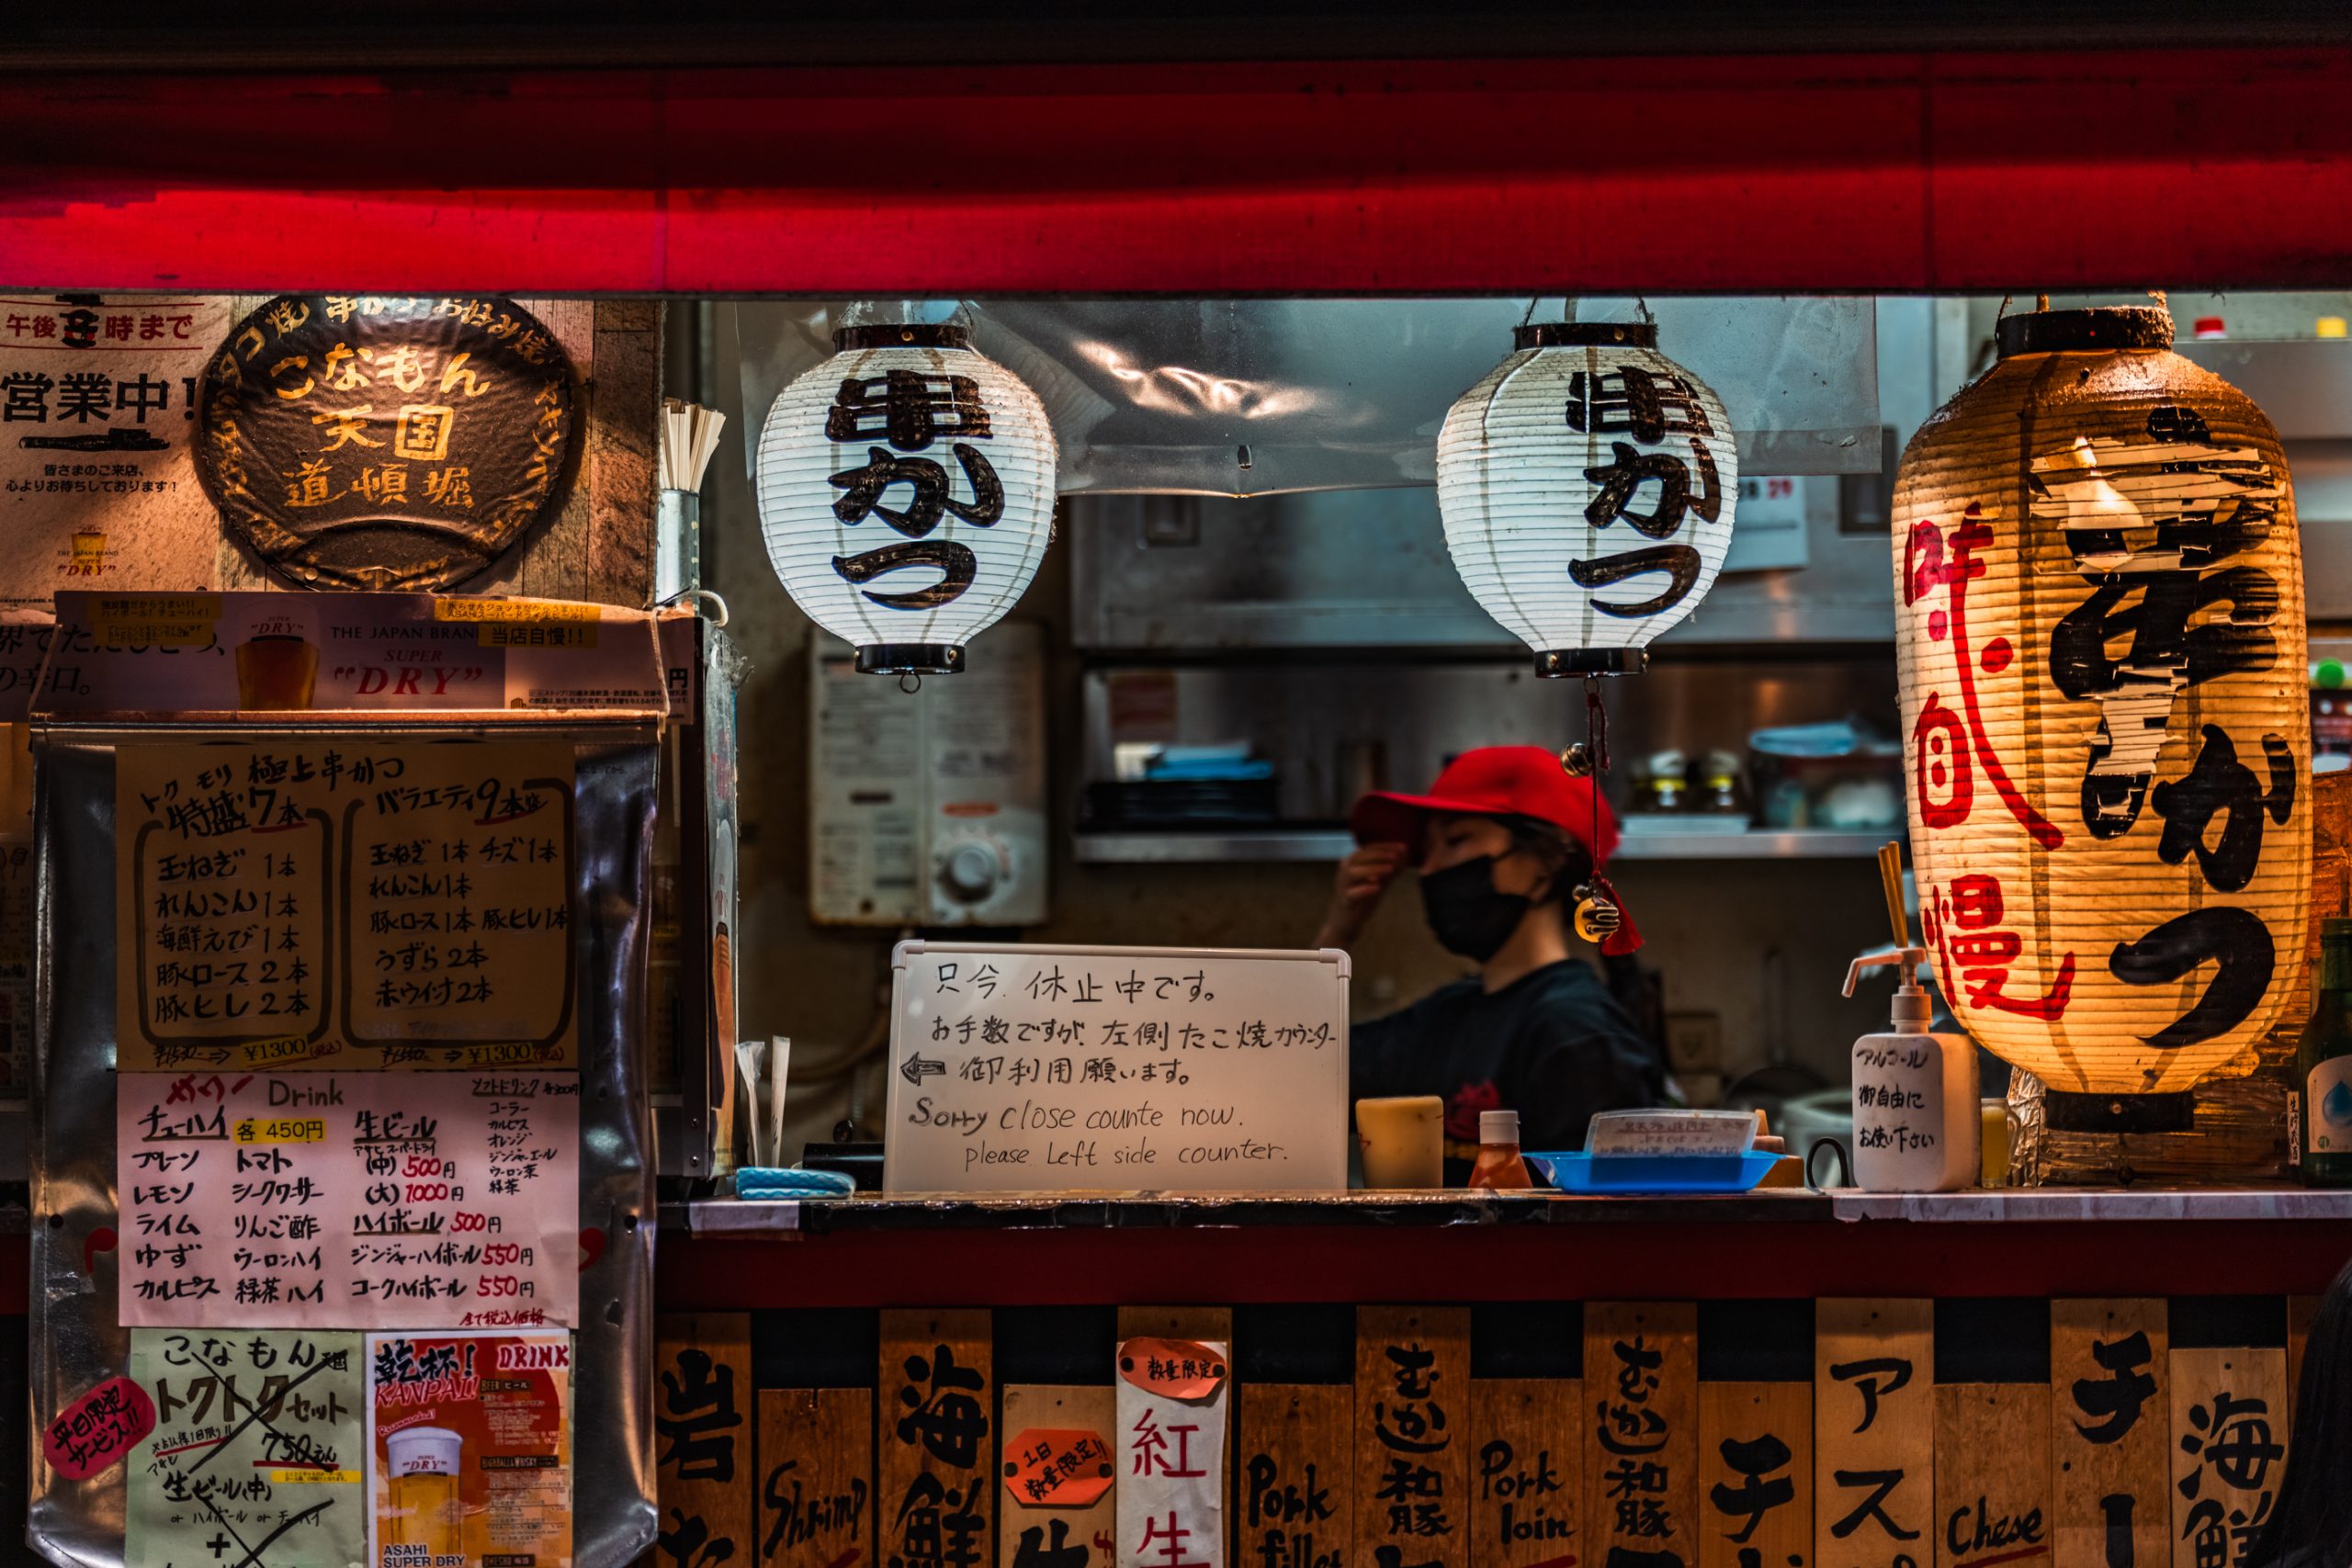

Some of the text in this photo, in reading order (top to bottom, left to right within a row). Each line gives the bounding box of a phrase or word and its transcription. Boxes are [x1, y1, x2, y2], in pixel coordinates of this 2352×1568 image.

[270, 342, 490, 399] こなもん
[0, 371, 197, 423] 営業中!
[312, 403, 454, 460] 天国
[44, 464, 145, 478] 皆さまのご来店、
[282, 458, 475, 509] 道頓堀
[6, 479, 177, 493] 心よりお待ちしております!
[825, 369, 1005, 611] 串かつ
[1566, 366, 1722, 618] 串かつ
[332, 626, 479, 639] THE JAPAN BRAN
[492, 626, 584, 646] 当店自慢!!
[385, 649, 442, 662] SUPER
[668, 668, 689, 690] 円
[248, 750, 405, 792] 極上串かつ
[1904, 502, 2076, 1021] 味自慢
[157, 847, 297, 882] 玉ねぎ 1本
[369, 838, 433, 866] 玉ねぎ
[441, 838, 470, 863] 1本
[527, 837, 560, 863] 1本
[369, 872, 473, 899] れんこん 1本
[154, 888, 300, 919] れんこん 1本
[370, 909, 440, 935] 豚ロース
[445, 906, 476, 934] 1本
[155, 922, 300, 954] 海鮮えび 1本
[375, 940, 490, 972] うずら 2本
[155, 955, 309, 988] 豚ロース 2本
[1023, 964, 1215, 1004] 休止中です。
[258, 988, 311, 1017] 2本
[456, 974, 494, 1004] 2本
[243, 1038, 307, 1063] ¥1300
[467, 1043, 531, 1063] ¥1300
[1856, 1048, 1928, 1070] アルコール
[959, 1055, 1190, 1086] 御利用願います。
[268, 1077, 345, 1108] Drink
[471, 1077, 540, 1095] ソフトドリンク
[1858, 1083, 1926, 1110] 御自由に
[138, 1104, 227, 1139] チューハイ
[237, 1120, 323, 1141] 各 450円
[355, 1109, 437, 1139] 生ビール
[488, 1118, 530, 1131] カルピス
[908, 1096, 988, 1136] Sorry
[1086, 1100, 1163, 1130] counte
[1181, 1106, 1243, 1127] now.
[487, 1132, 533, 1147] オレンジ
[1859, 1124, 1935, 1154] お使い下さい
[132, 1147, 293, 1174] プレーン トマト
[401, 1155, 457, 1180] 500円
[965, 1140, 1030, 1173] please
[1114, 1135, 1157, 1165] side
[1178, 1138, 1288, 1165] counter.
[489, 1163, 540, 1179] ウーロン茶
[134, 1181, 194, 1204] レモン
[488, 1179, 521, 1195] 緑茶
[136, 1213, 322, 1240] ライム りんご酢
[353, 1208, 502, 1234] ハイボール 500円
[135, 1243, 322, 1271] ゆず ウーロンハイ
[481, 1242, 535, 1267] 550円
[133, 1276, 220, 1302] カルピス
[351, 1274, 535, 1301] コークハイボール 550円
[164, 1335, 317, 1370] こなもん
[375, 1338, 476, 1382] 乾杯!
[499, 1344, 570, 1370] DRINK
[1147, 1355, 1215, 1382] 数量限定
[156, 1373, 348, 1426] トクトク セット
[52, 1385, 132, 1450] 平日限定
[888, 1343, 989, 1568] 海鮮
[1478, 1439, 1566, 1501] Pork
[1829, 1357, 1921, 1568] アス
[1246, 1453, 1338, 1529] Pork
[763, 1459, 867, 1559] Shrimp
[1499, 1502, 1580, 1552] loin
[383, 1544, 427, 1556] ASAHI
[383, 1555, 465, 1568] SUPER DRY
